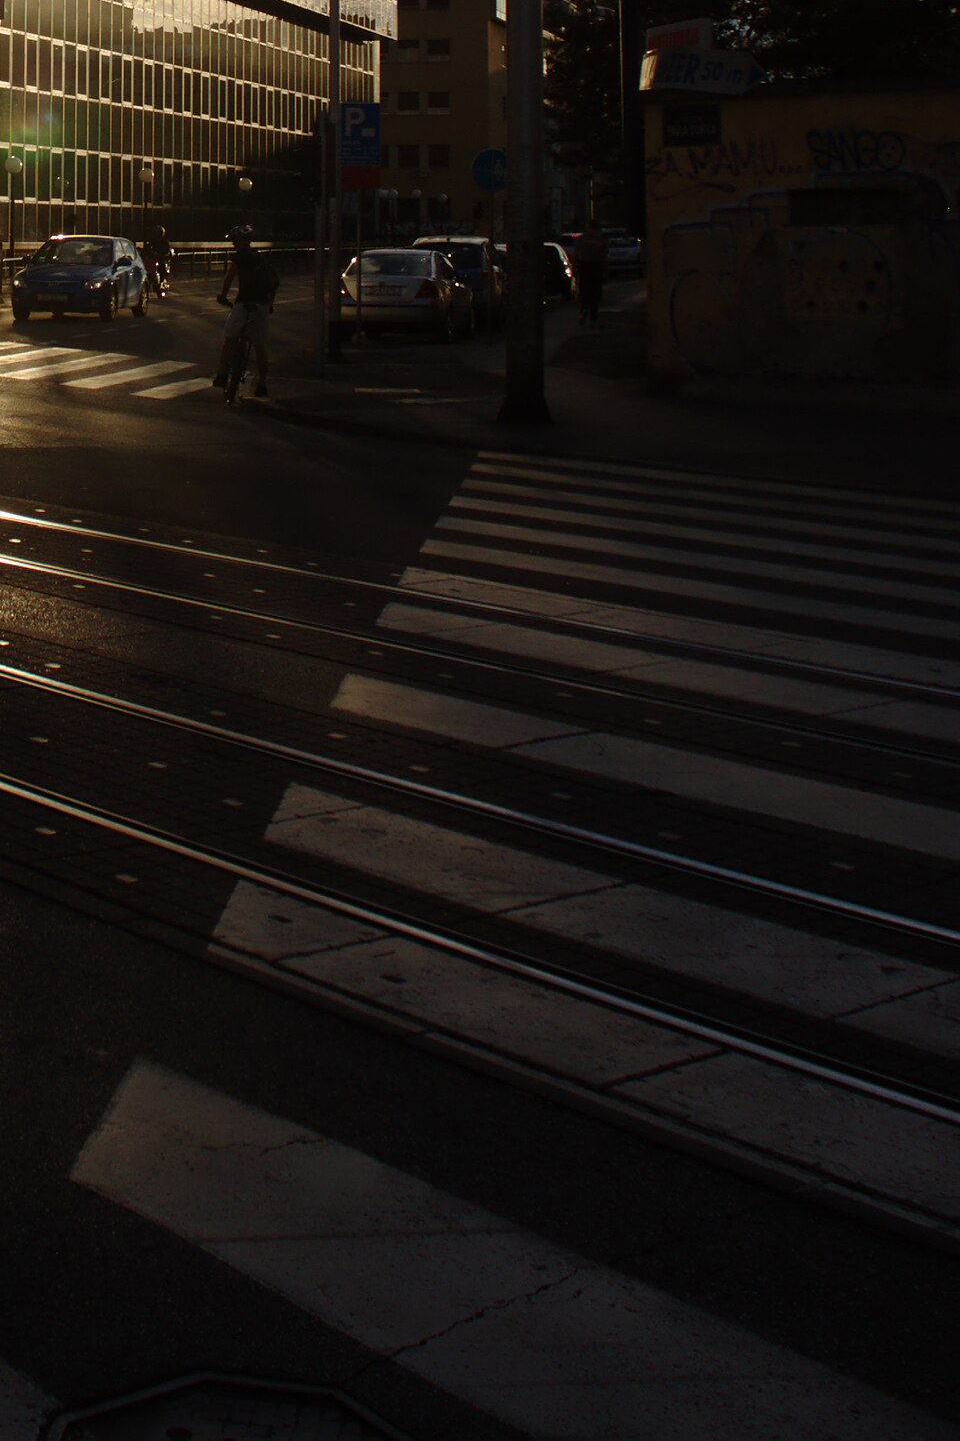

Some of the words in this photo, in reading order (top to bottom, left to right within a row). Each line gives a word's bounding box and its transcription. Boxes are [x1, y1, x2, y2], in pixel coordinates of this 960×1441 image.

[701, 61, 724, 81] 50
[725, 68, 743, 83] m
[344, 107, 366, 137] P
